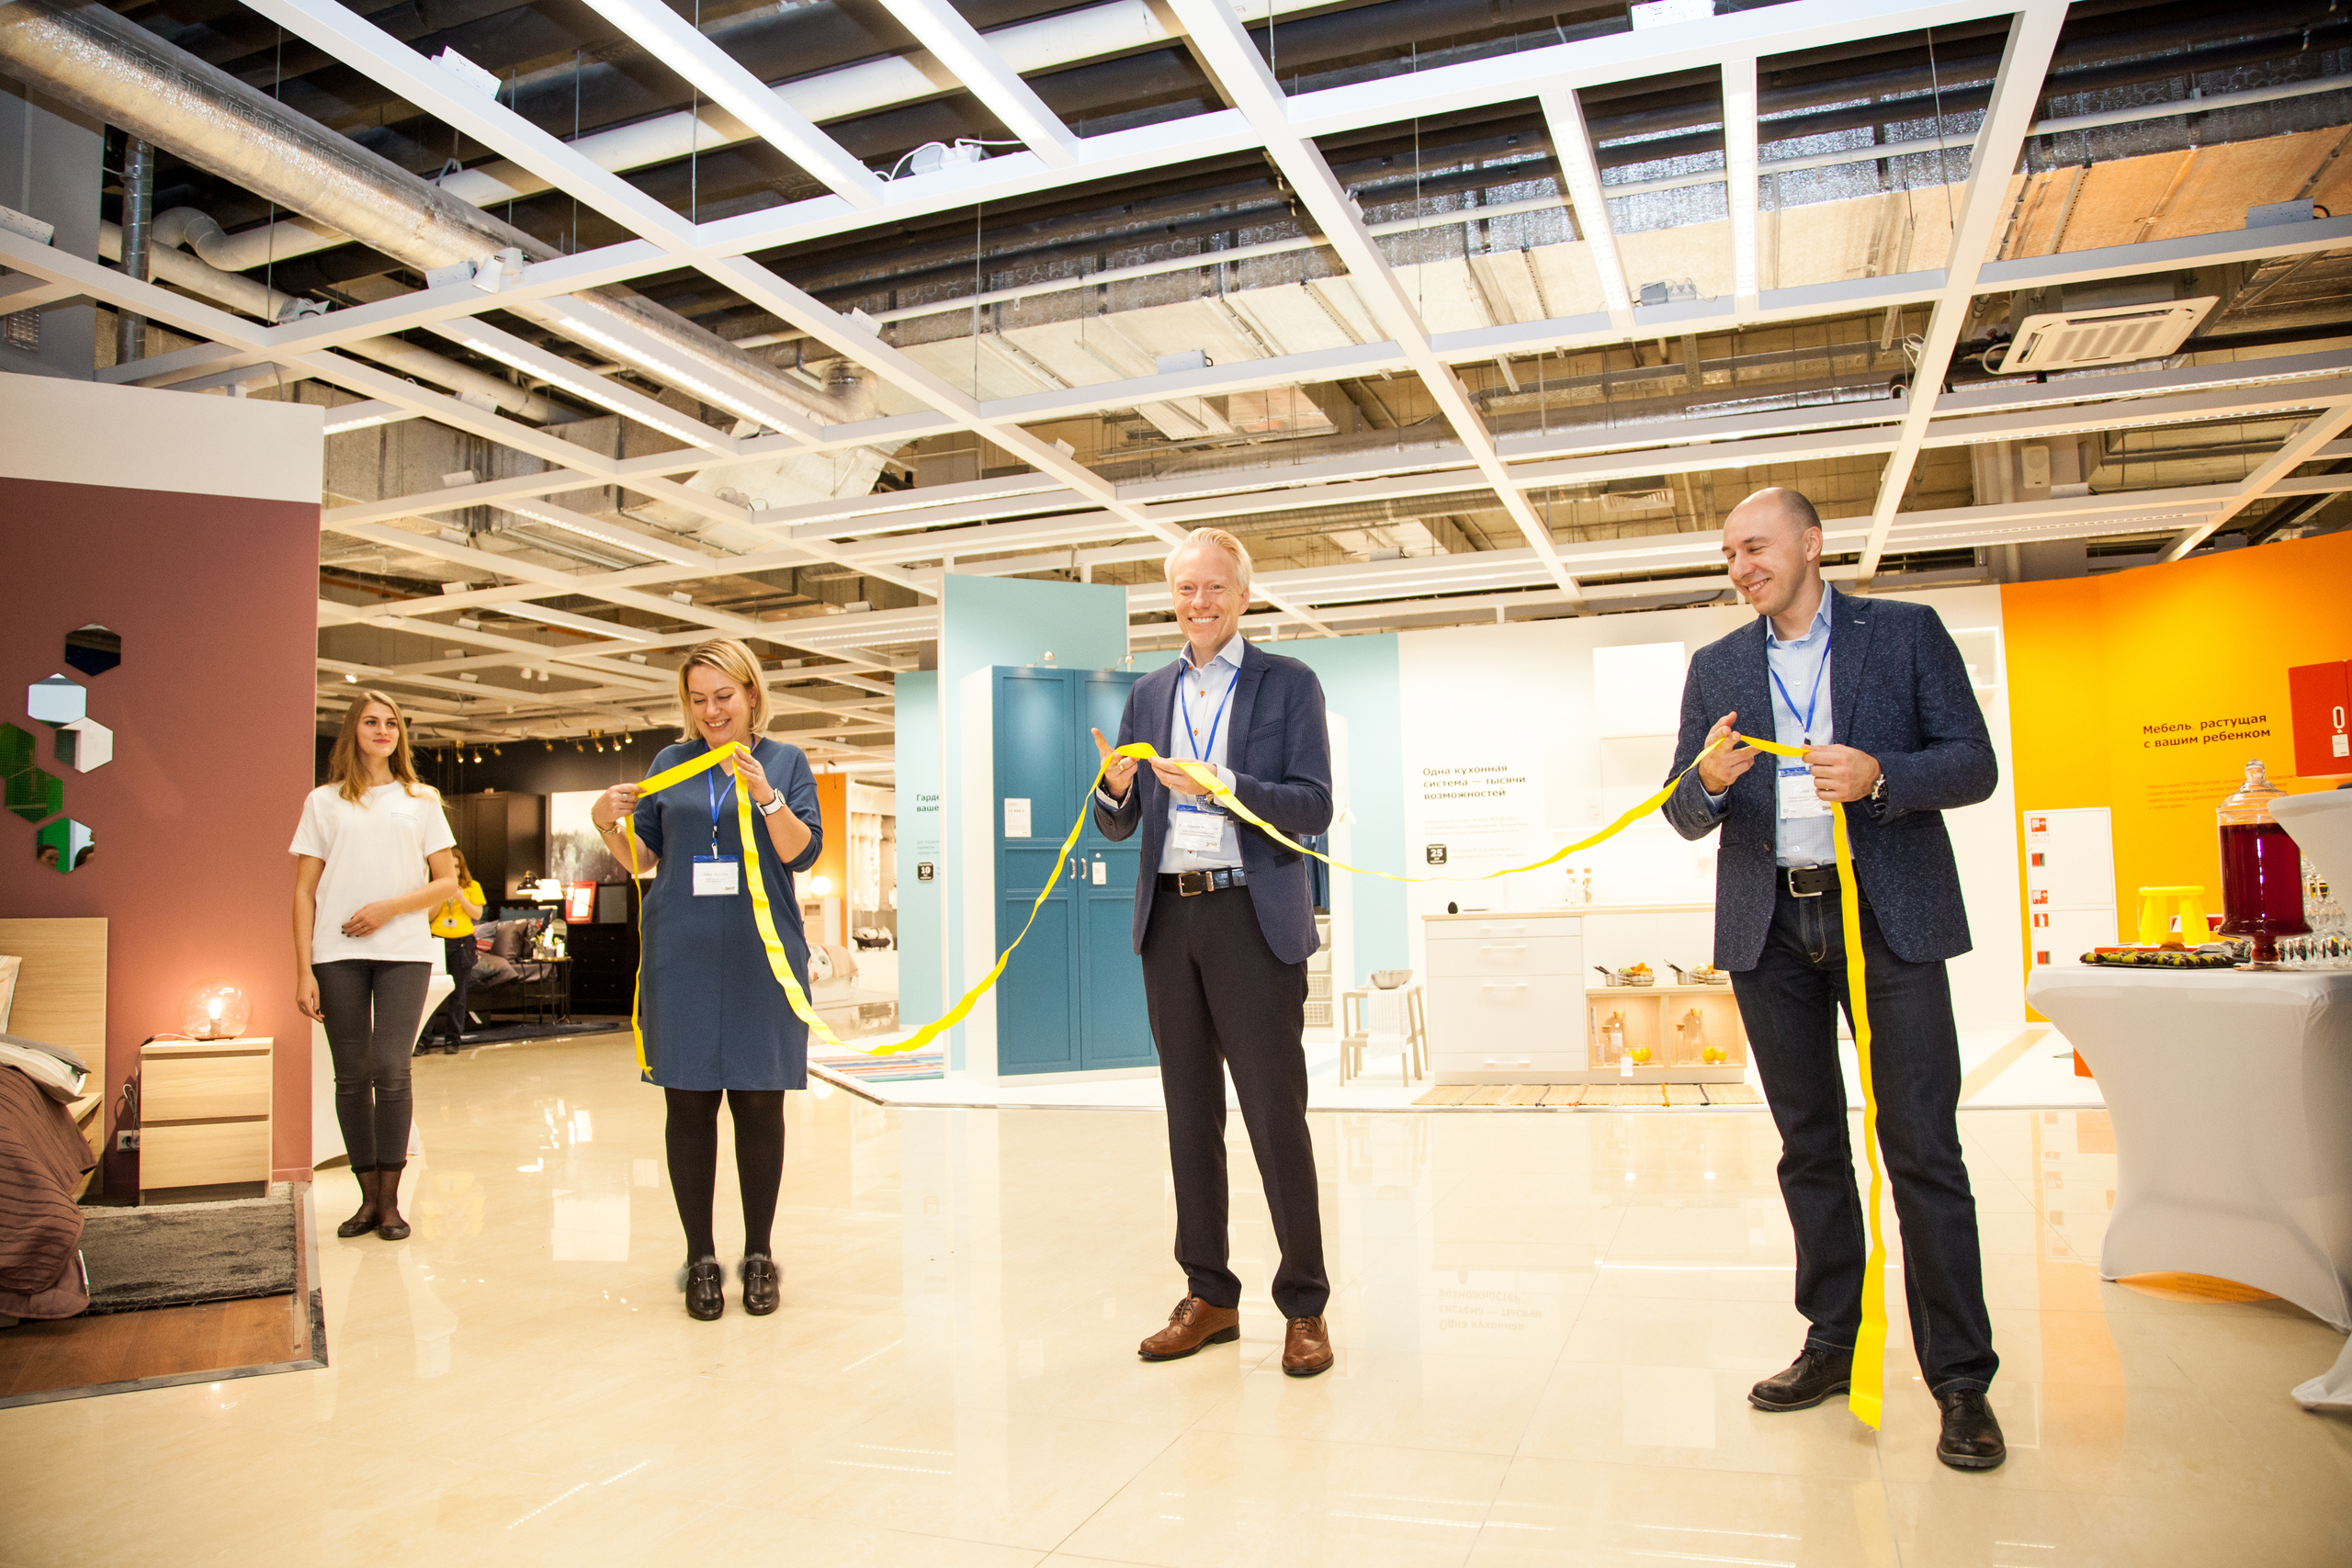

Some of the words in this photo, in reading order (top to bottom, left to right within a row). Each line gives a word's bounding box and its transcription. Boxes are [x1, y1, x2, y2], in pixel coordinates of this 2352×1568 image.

[2199, 715, 2267, 730] растущая
[2143, 740, 2151, 749] с
[2154, 736, 2199, 748] вашим
[2202, 729, 2271, 745] ребенком
[1422, 767, 1451, 776] Одна
[1454, 765, 1508, 776] кухонная
[1423, 779, 1468, 788] система
[1485, 776, 1526, 785] тысячи
[1424, 787, 1506, 800] возможностей
[1430, 849, 1443, 858] 25
[921, 866, 932, 874] 10
